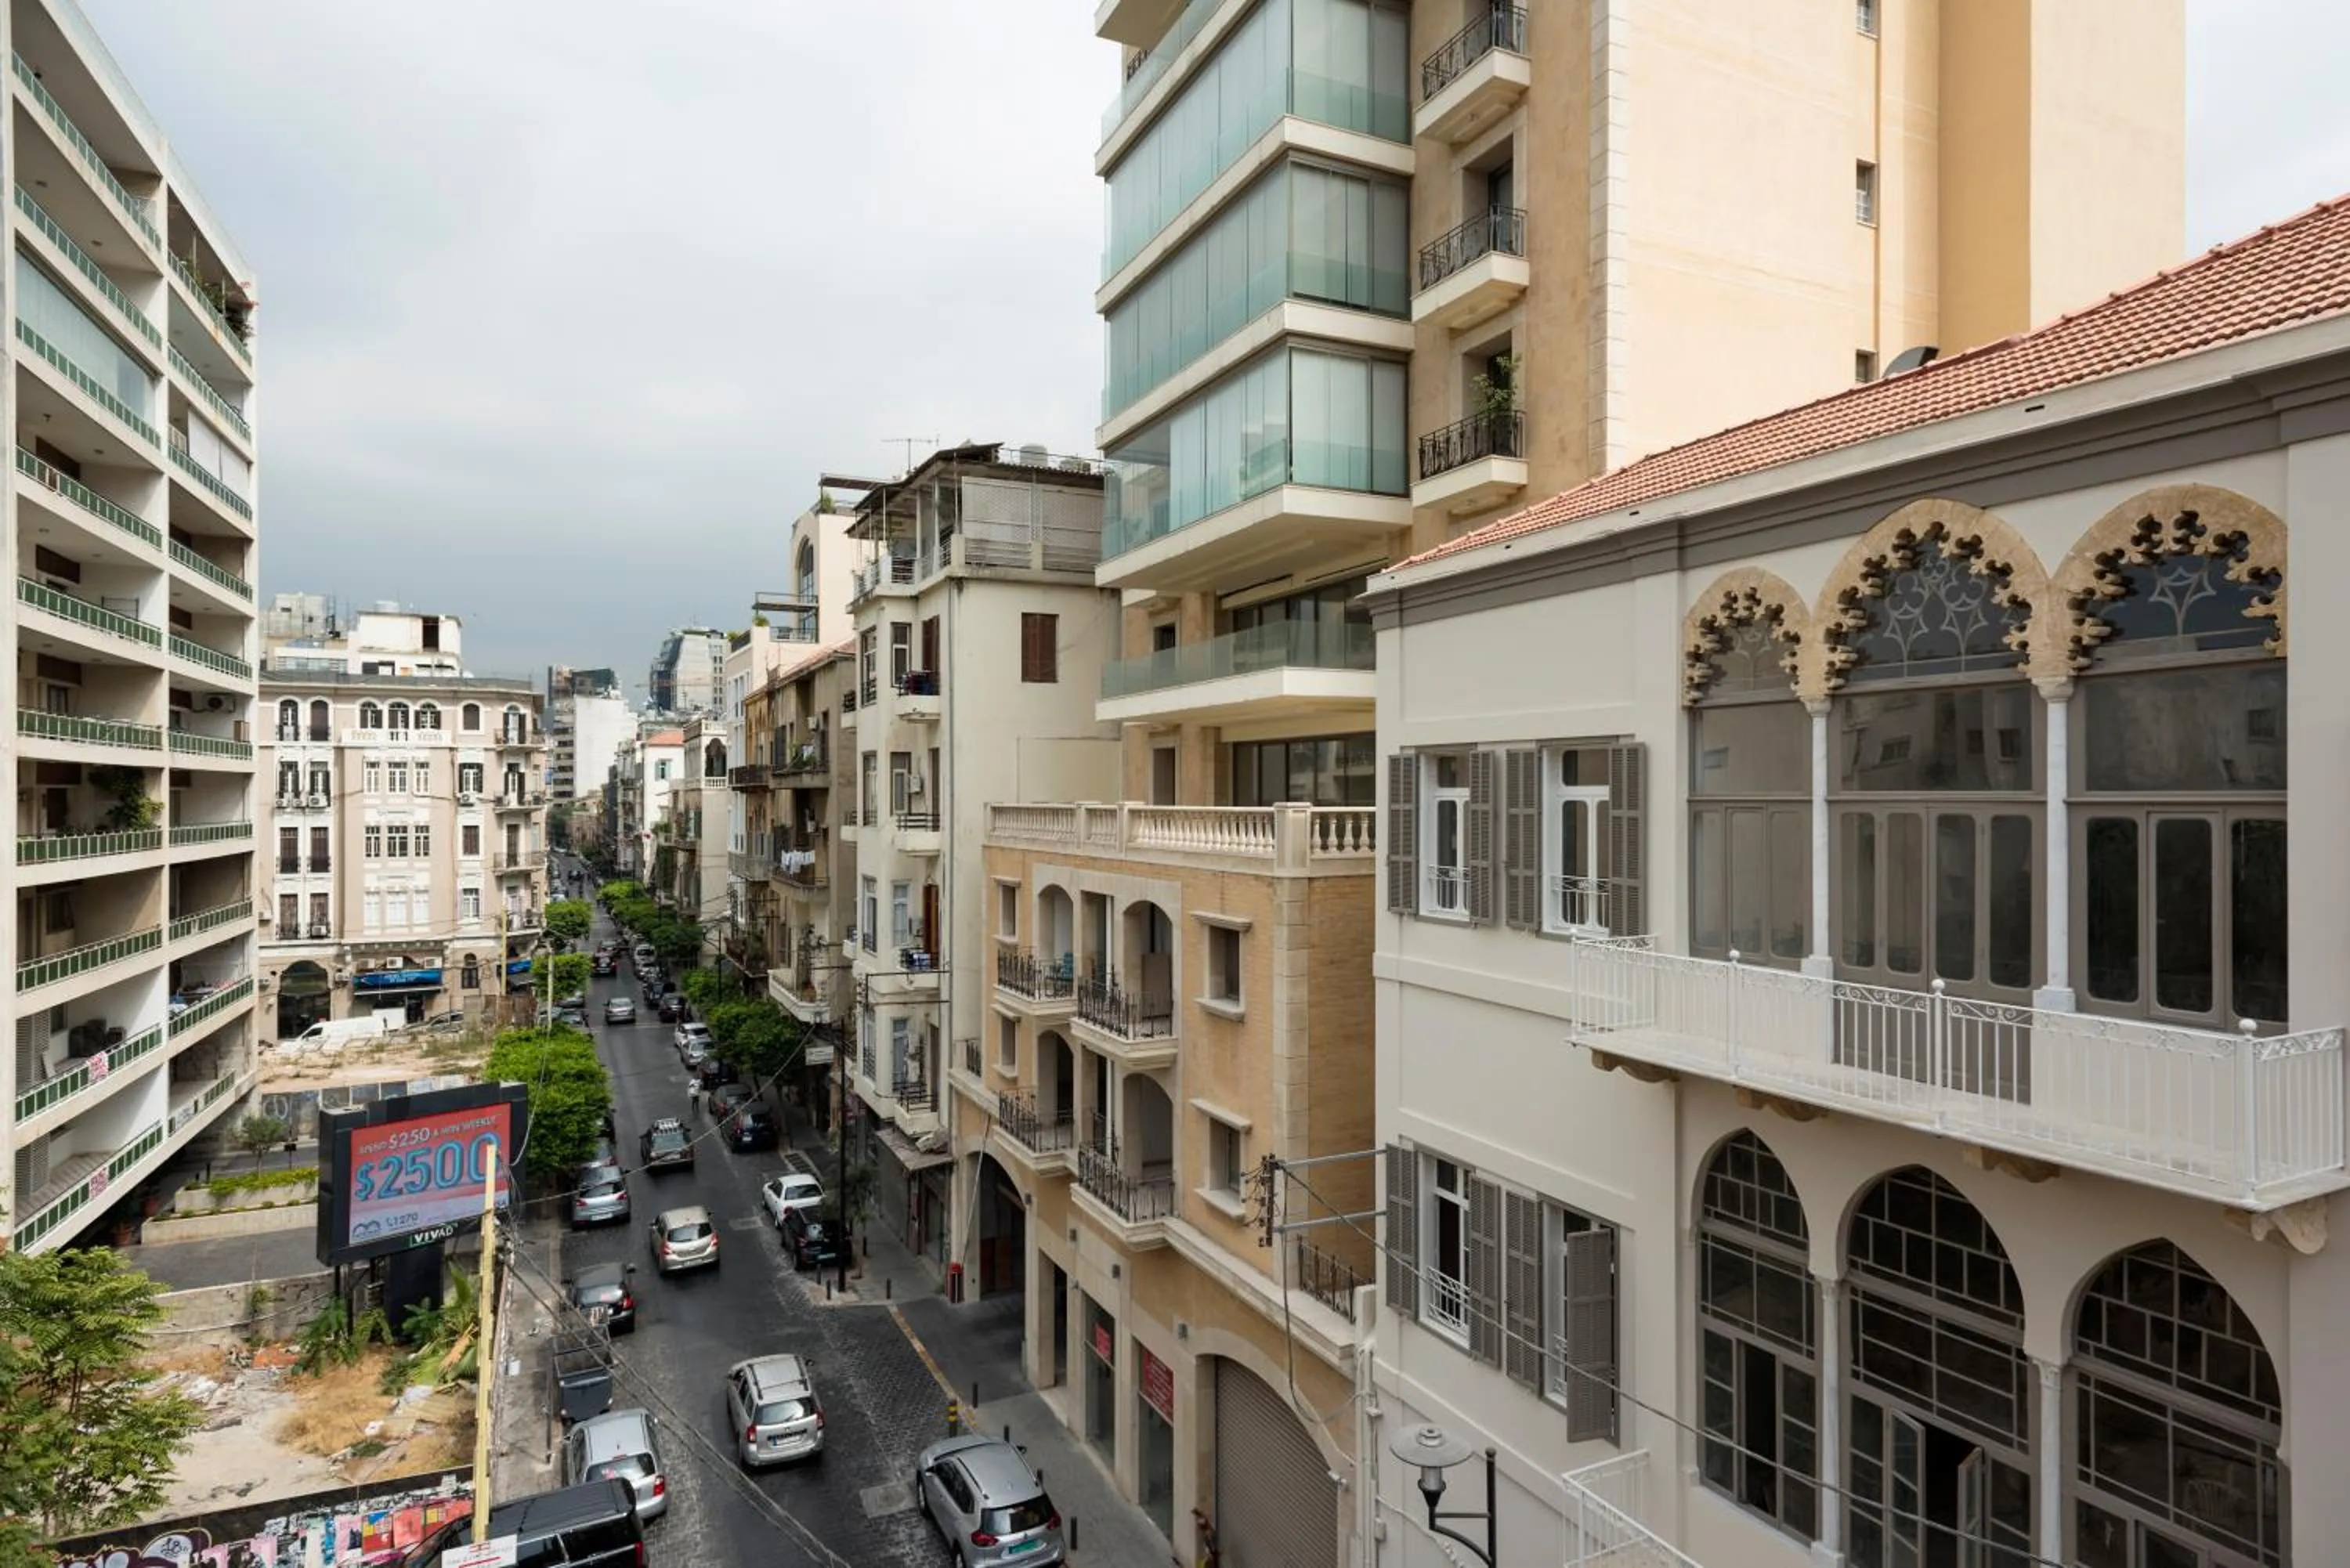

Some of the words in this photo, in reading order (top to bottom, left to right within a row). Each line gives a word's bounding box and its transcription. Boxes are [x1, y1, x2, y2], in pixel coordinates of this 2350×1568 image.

[389, 1128, 430, 1149] $250
[461, 1115, 496, 1130] WEEKLY
[355, 1132, 501, 1201] $2500
[414, 1227, 454, 1244] VIVAD
